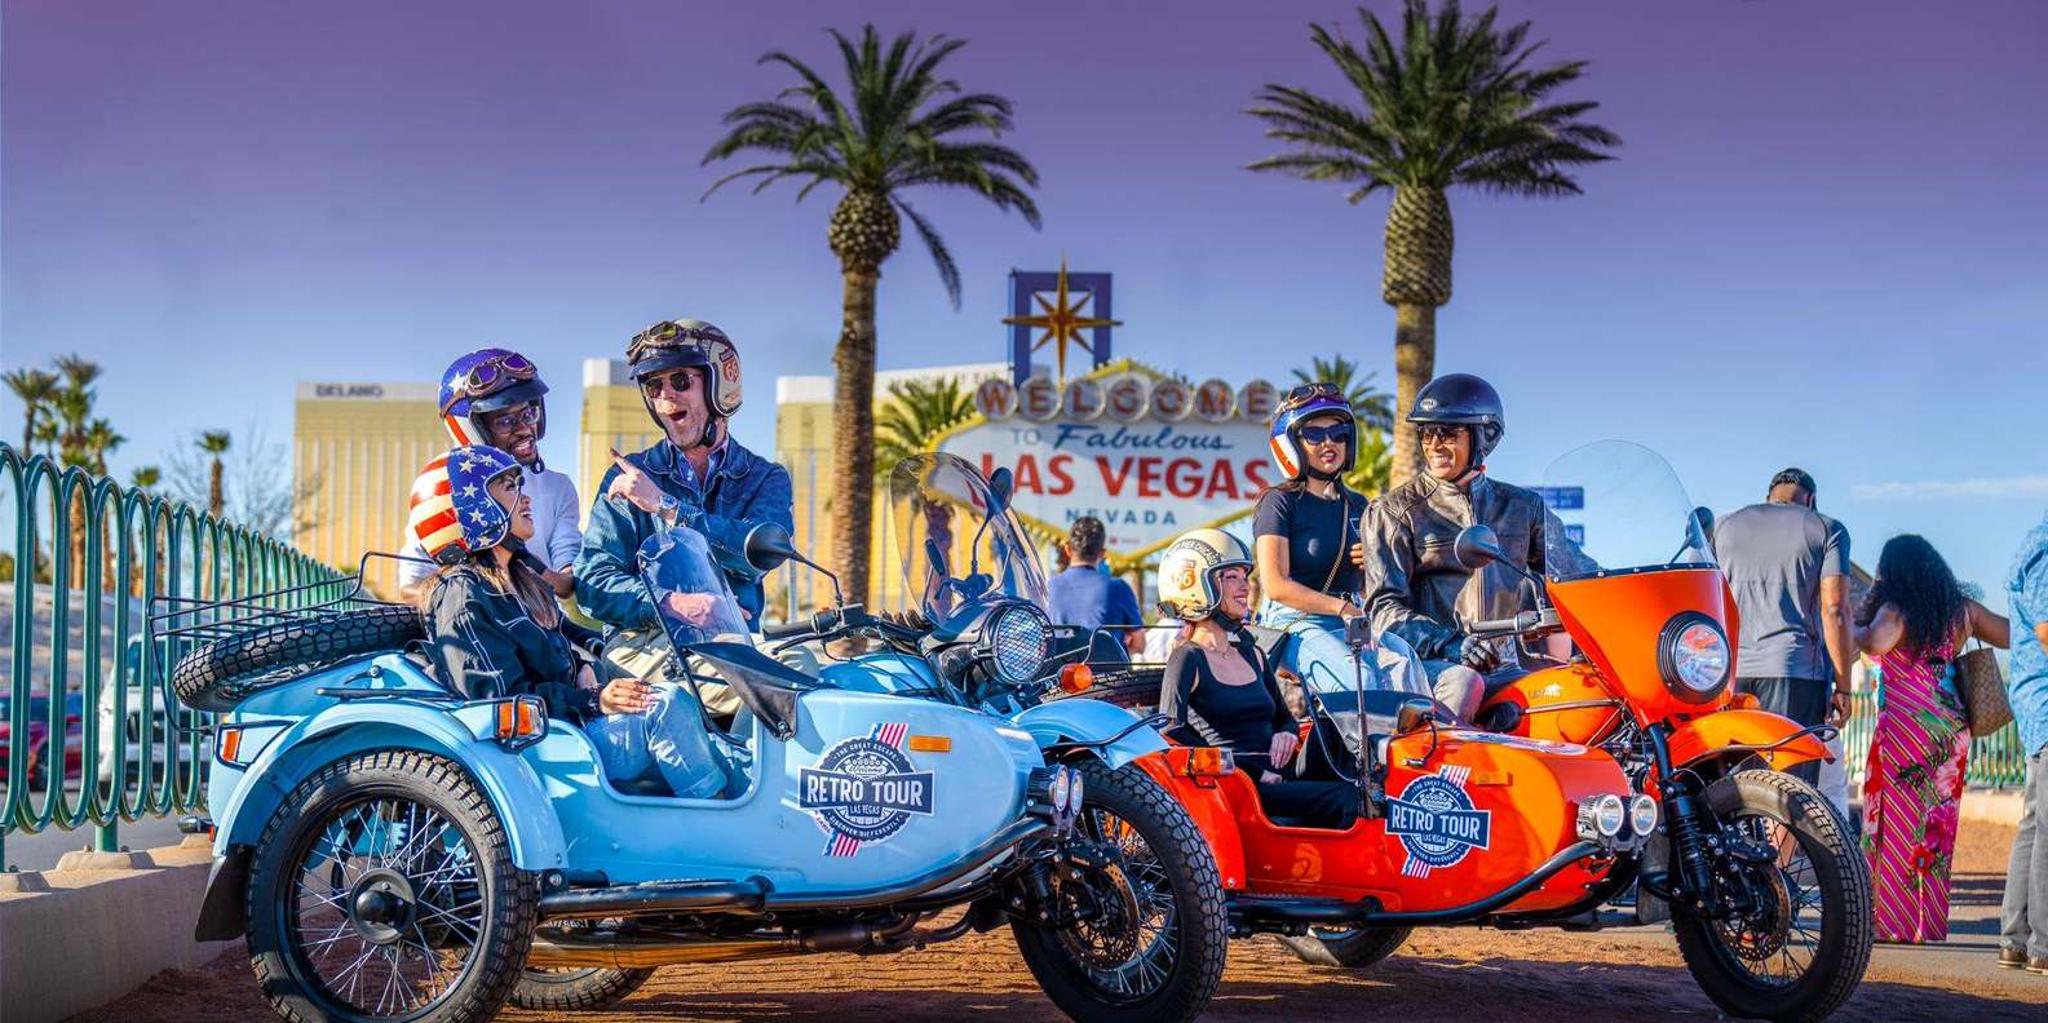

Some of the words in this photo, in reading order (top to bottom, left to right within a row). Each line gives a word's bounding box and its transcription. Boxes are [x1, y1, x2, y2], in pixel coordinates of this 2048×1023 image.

[315, 384, 383, 397] DELANO
[977, 384, 1272, 418] WELCOME
[1010, 428, 1042, 446] TO
[1053, 423, 1234, 450] Fabulous
[1097, 455, 1270, 501] VEGAS
[807, 775, 863, 803] RETRO
[871, 781, 923, 807] TOUR
[850, 804, 861, 814] LAS
[862, 805, 880, 815] VEGAS
[1392, 804, 1434, 831] RETRO
[1440, 814, 1481, 840] TOUR
